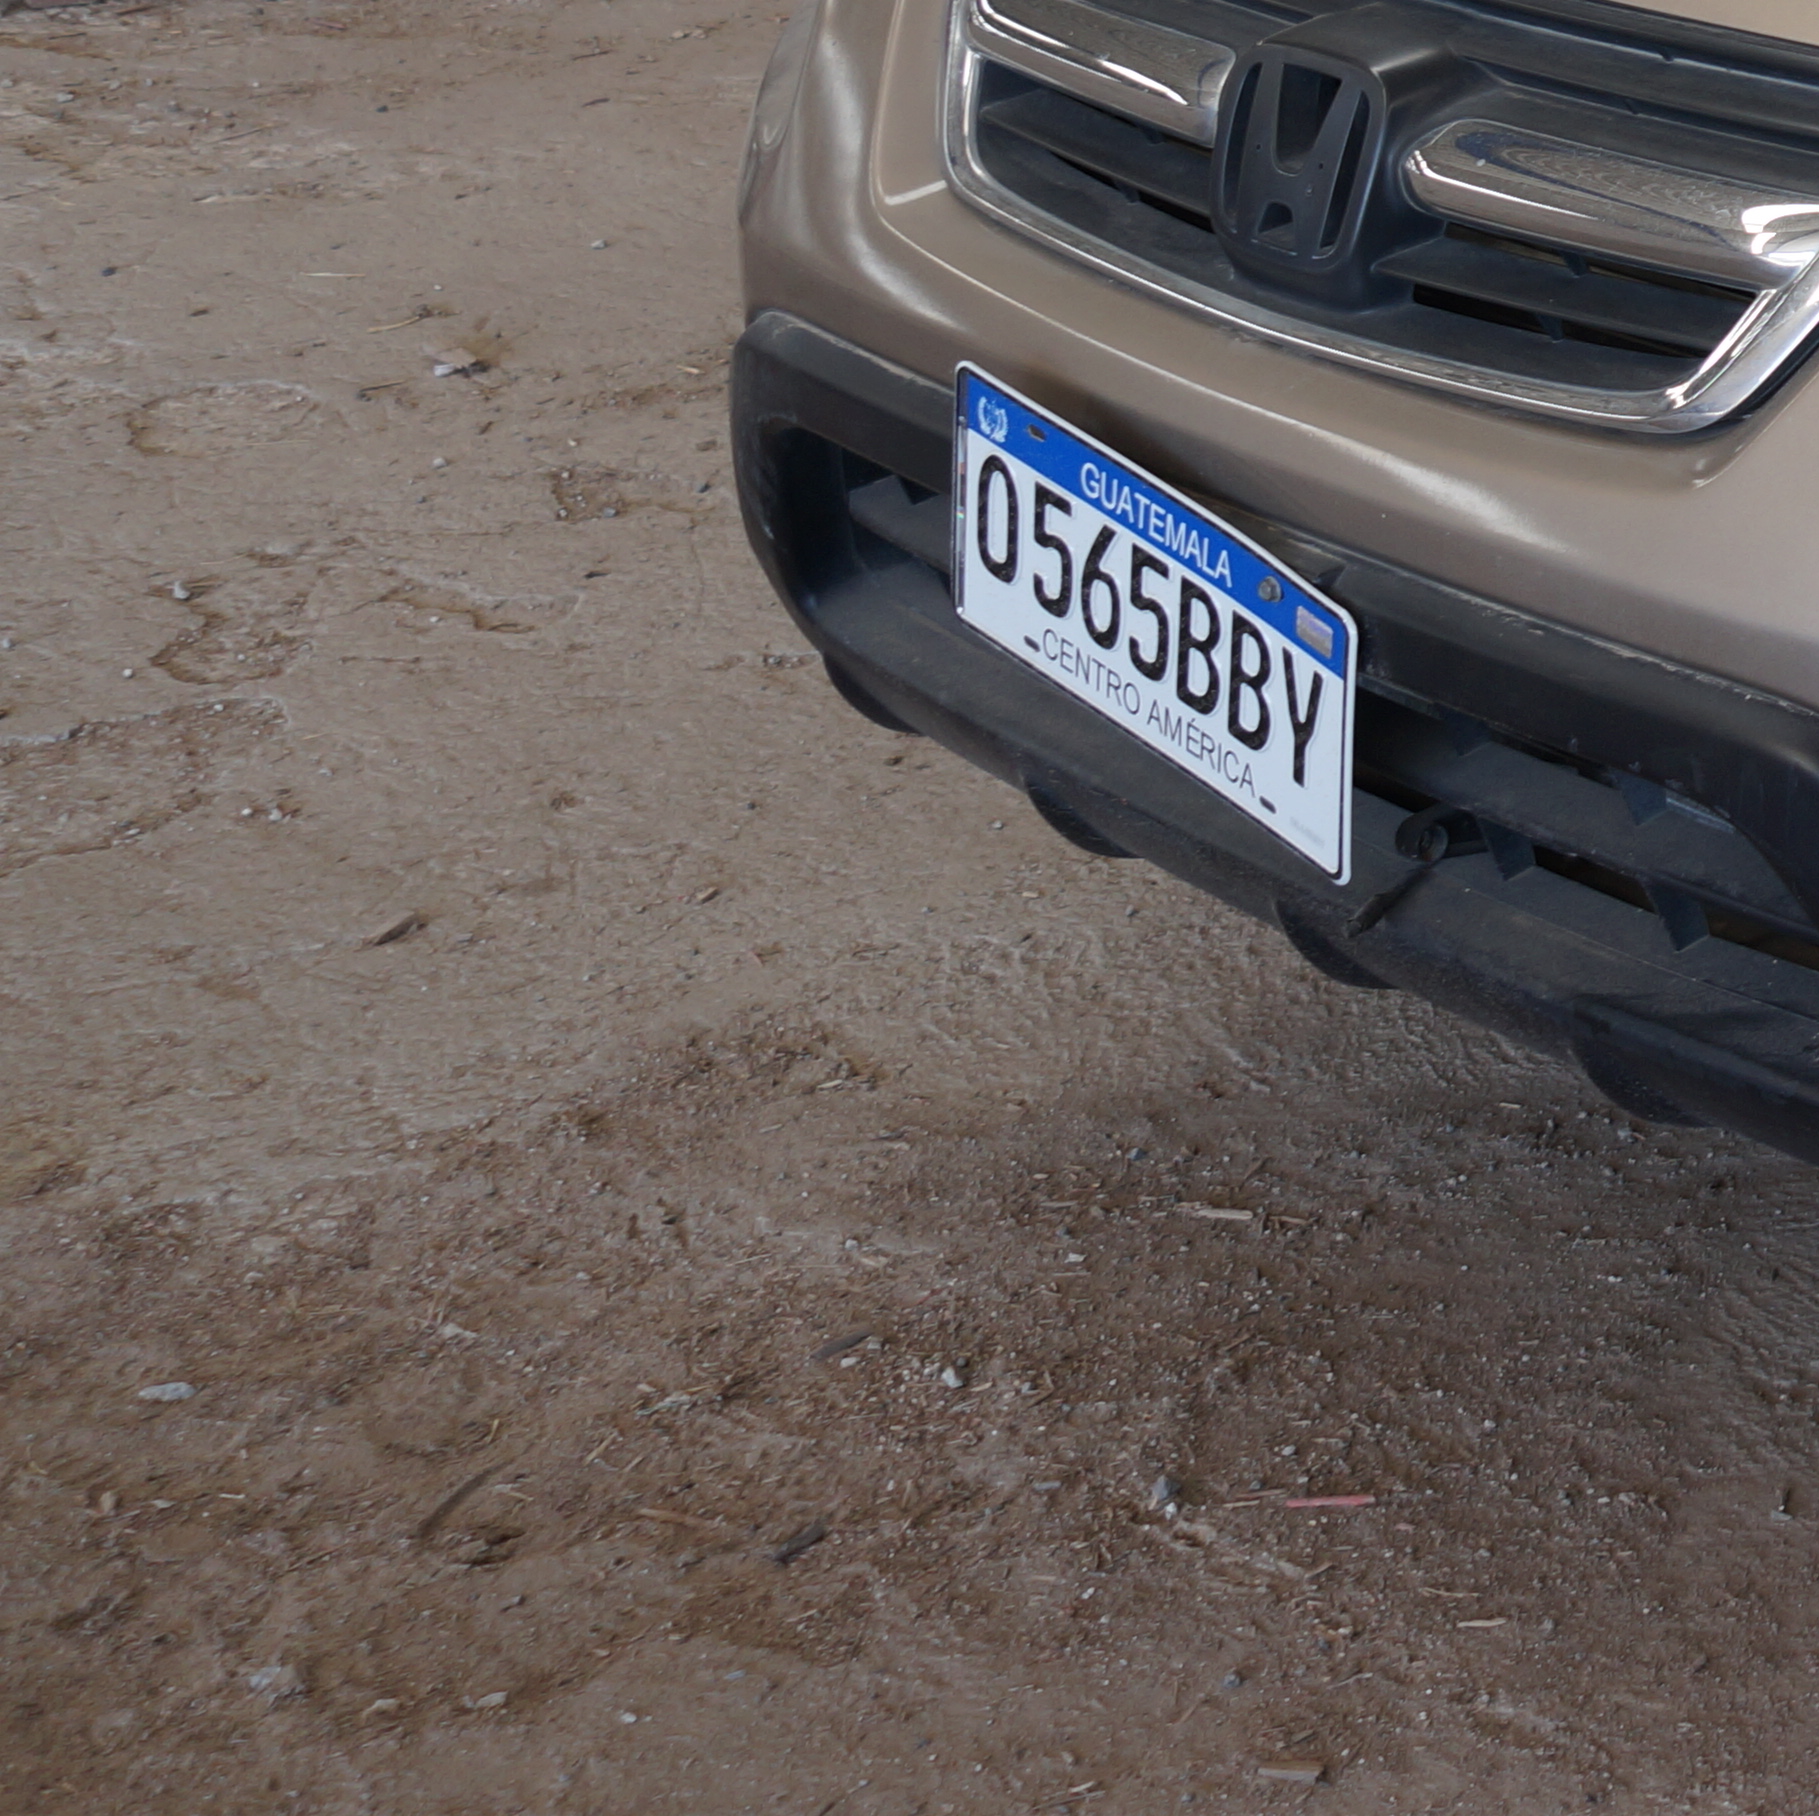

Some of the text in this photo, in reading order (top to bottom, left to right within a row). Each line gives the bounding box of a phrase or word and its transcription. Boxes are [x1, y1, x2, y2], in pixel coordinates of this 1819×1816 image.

[1080, 462, 1233, 587] GUATEMALA
[1043, 627, 1257, 799] CENTRO AMÉRICA
